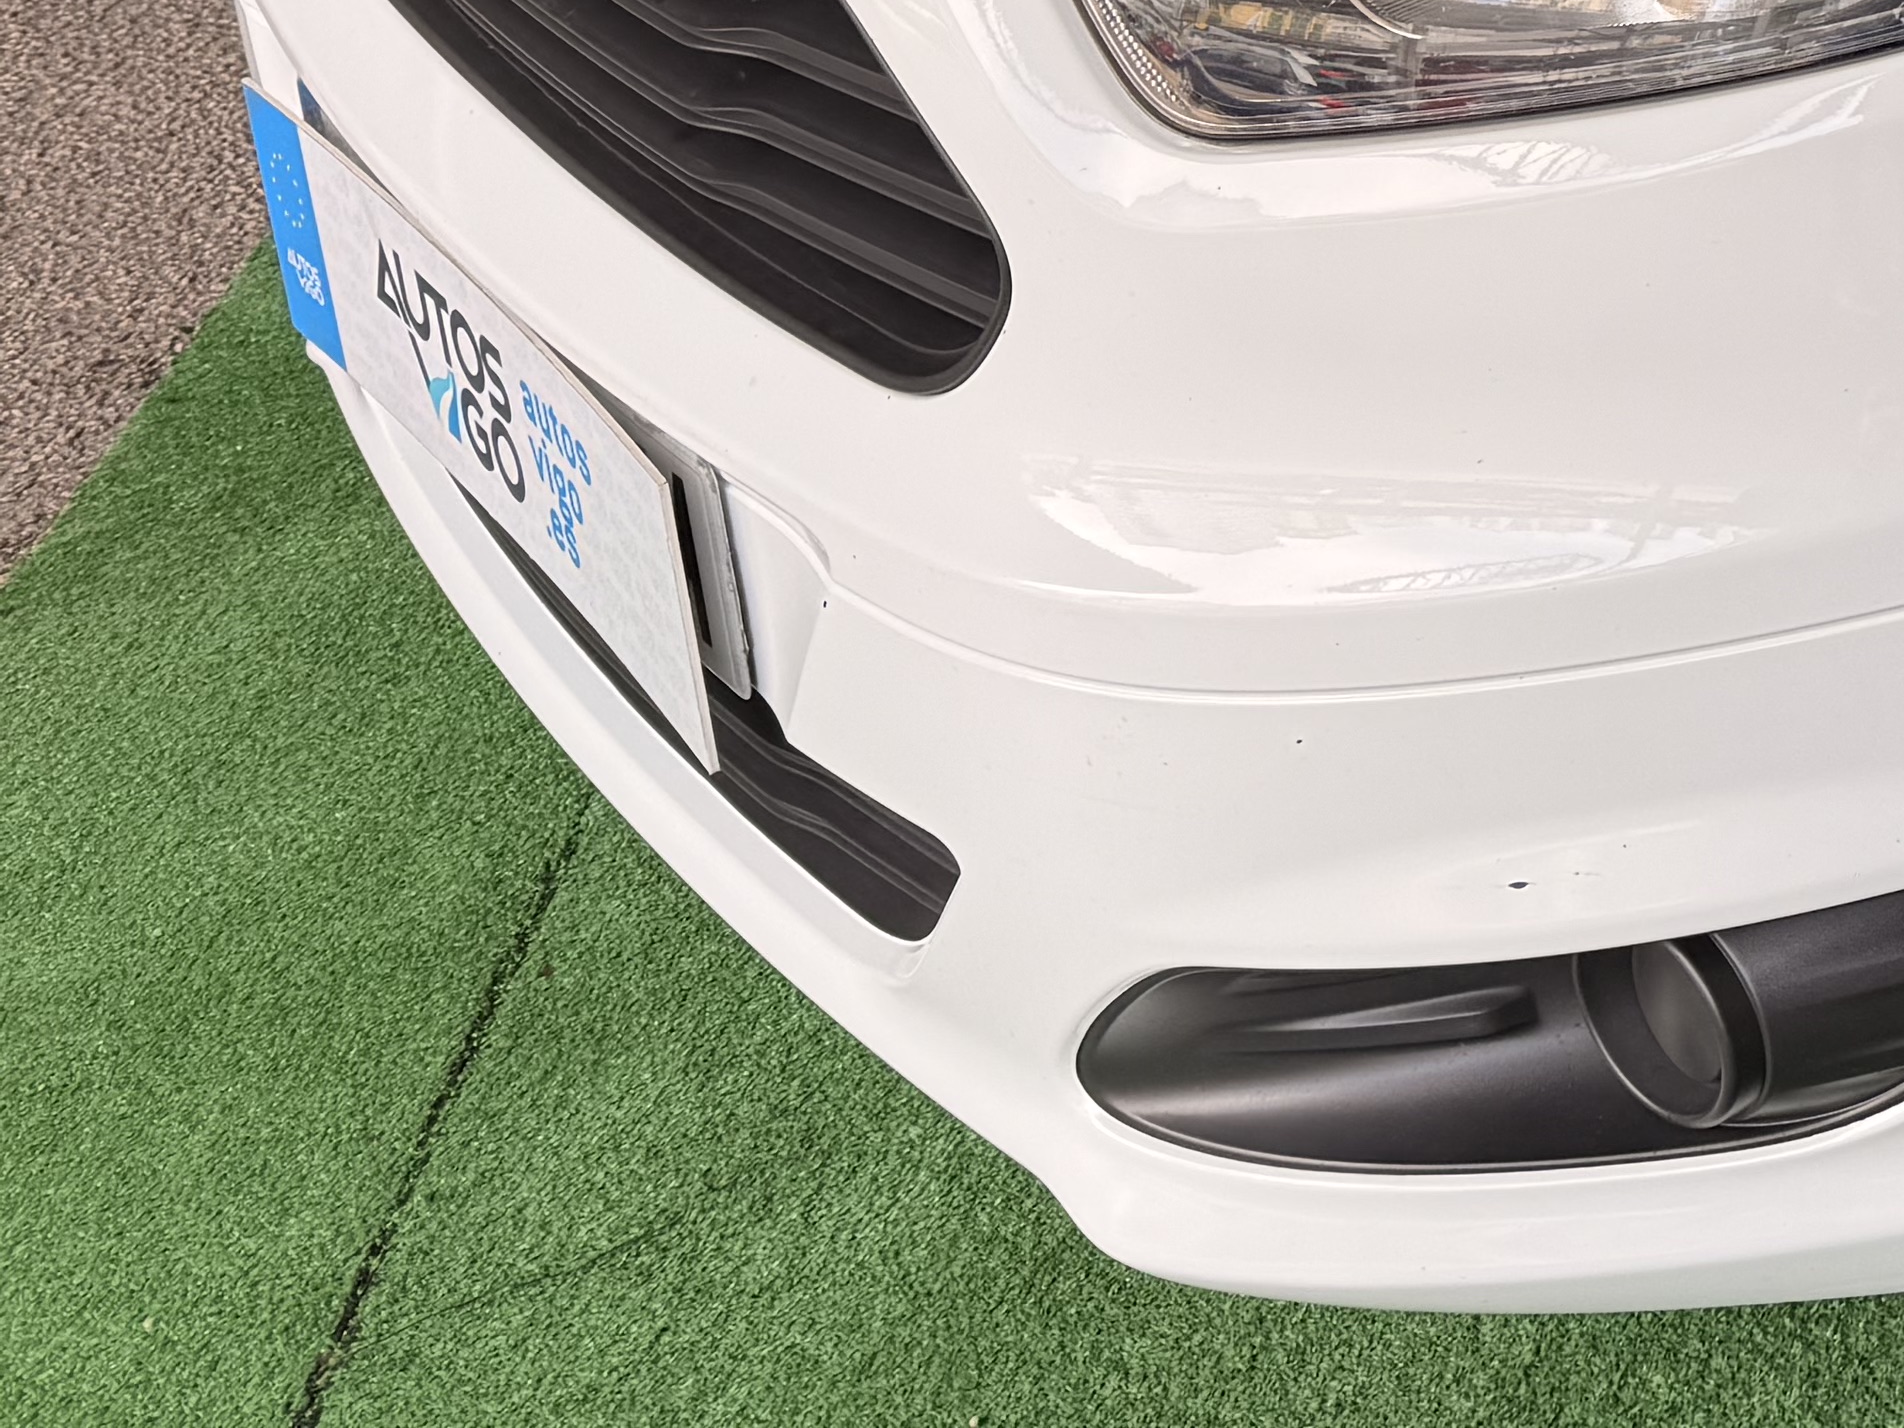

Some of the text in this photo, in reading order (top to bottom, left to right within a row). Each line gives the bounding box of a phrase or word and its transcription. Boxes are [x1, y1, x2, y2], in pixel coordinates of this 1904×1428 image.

[377, 238, 512, 425] AUTOS
[519, 379, 592, 487] autos
[528, 434, 584, 530] vigo
